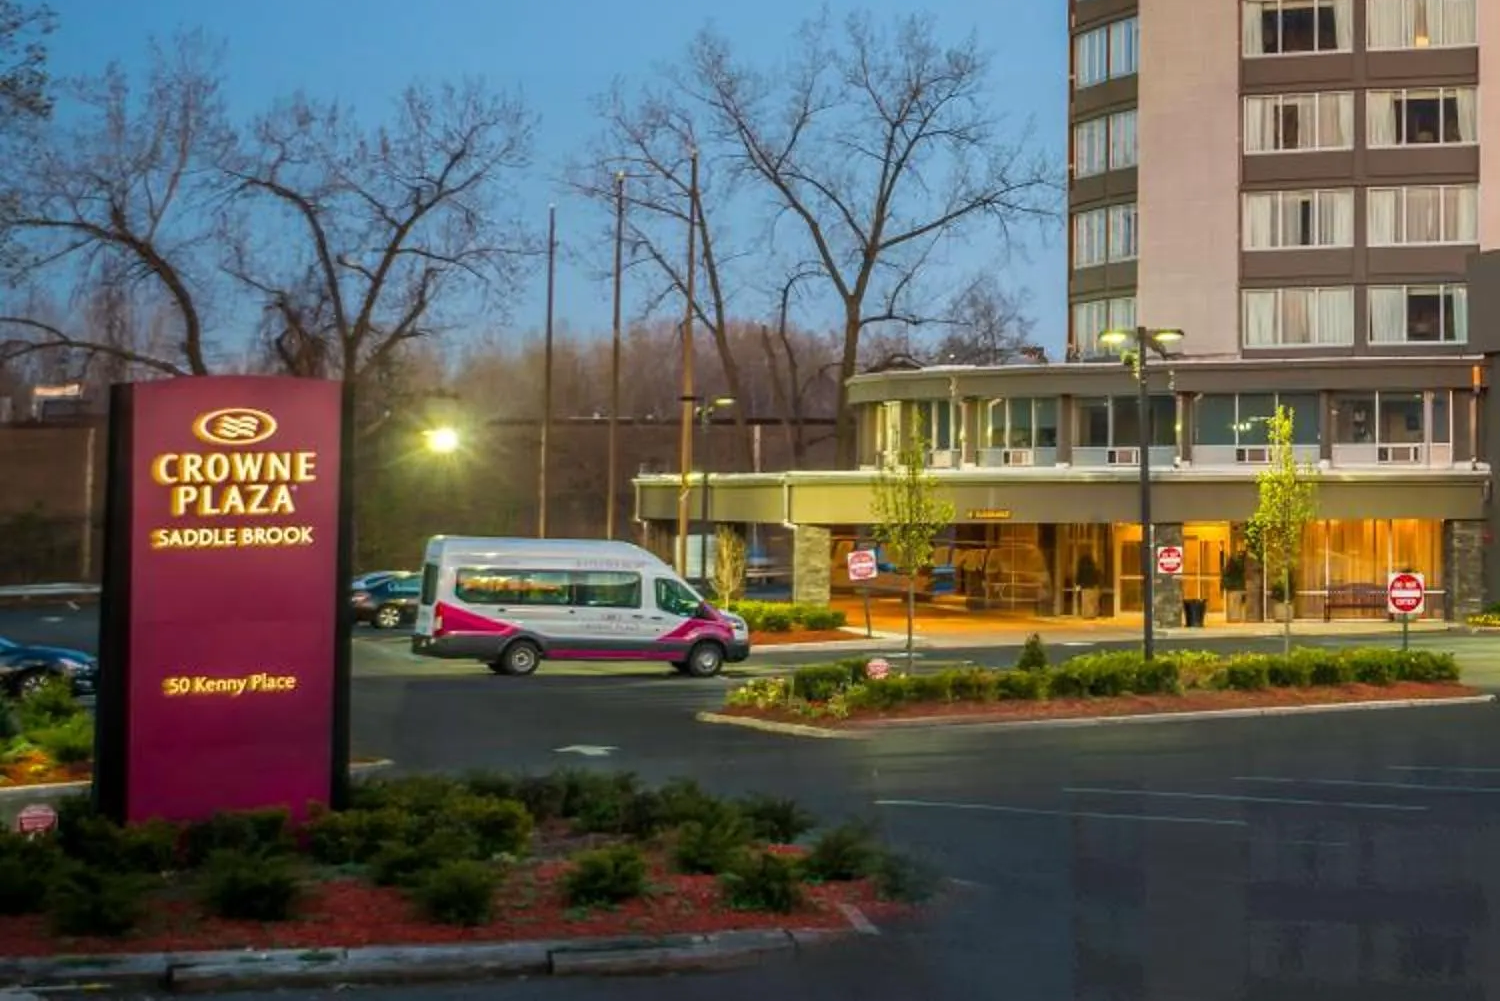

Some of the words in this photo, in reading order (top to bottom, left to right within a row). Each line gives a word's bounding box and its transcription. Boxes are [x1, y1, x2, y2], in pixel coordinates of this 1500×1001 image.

[153, 452, 317, 485] CROWNE
[172, 484, 296, 516] PLAZA
[152, 528, 236, 547] SADDLE
[239, 526, 314, 545] BROOK
[164, 677, 190, 695] 50
[193, 676, 246, 698] Kenny
[249, 673, 297, 691] Place
